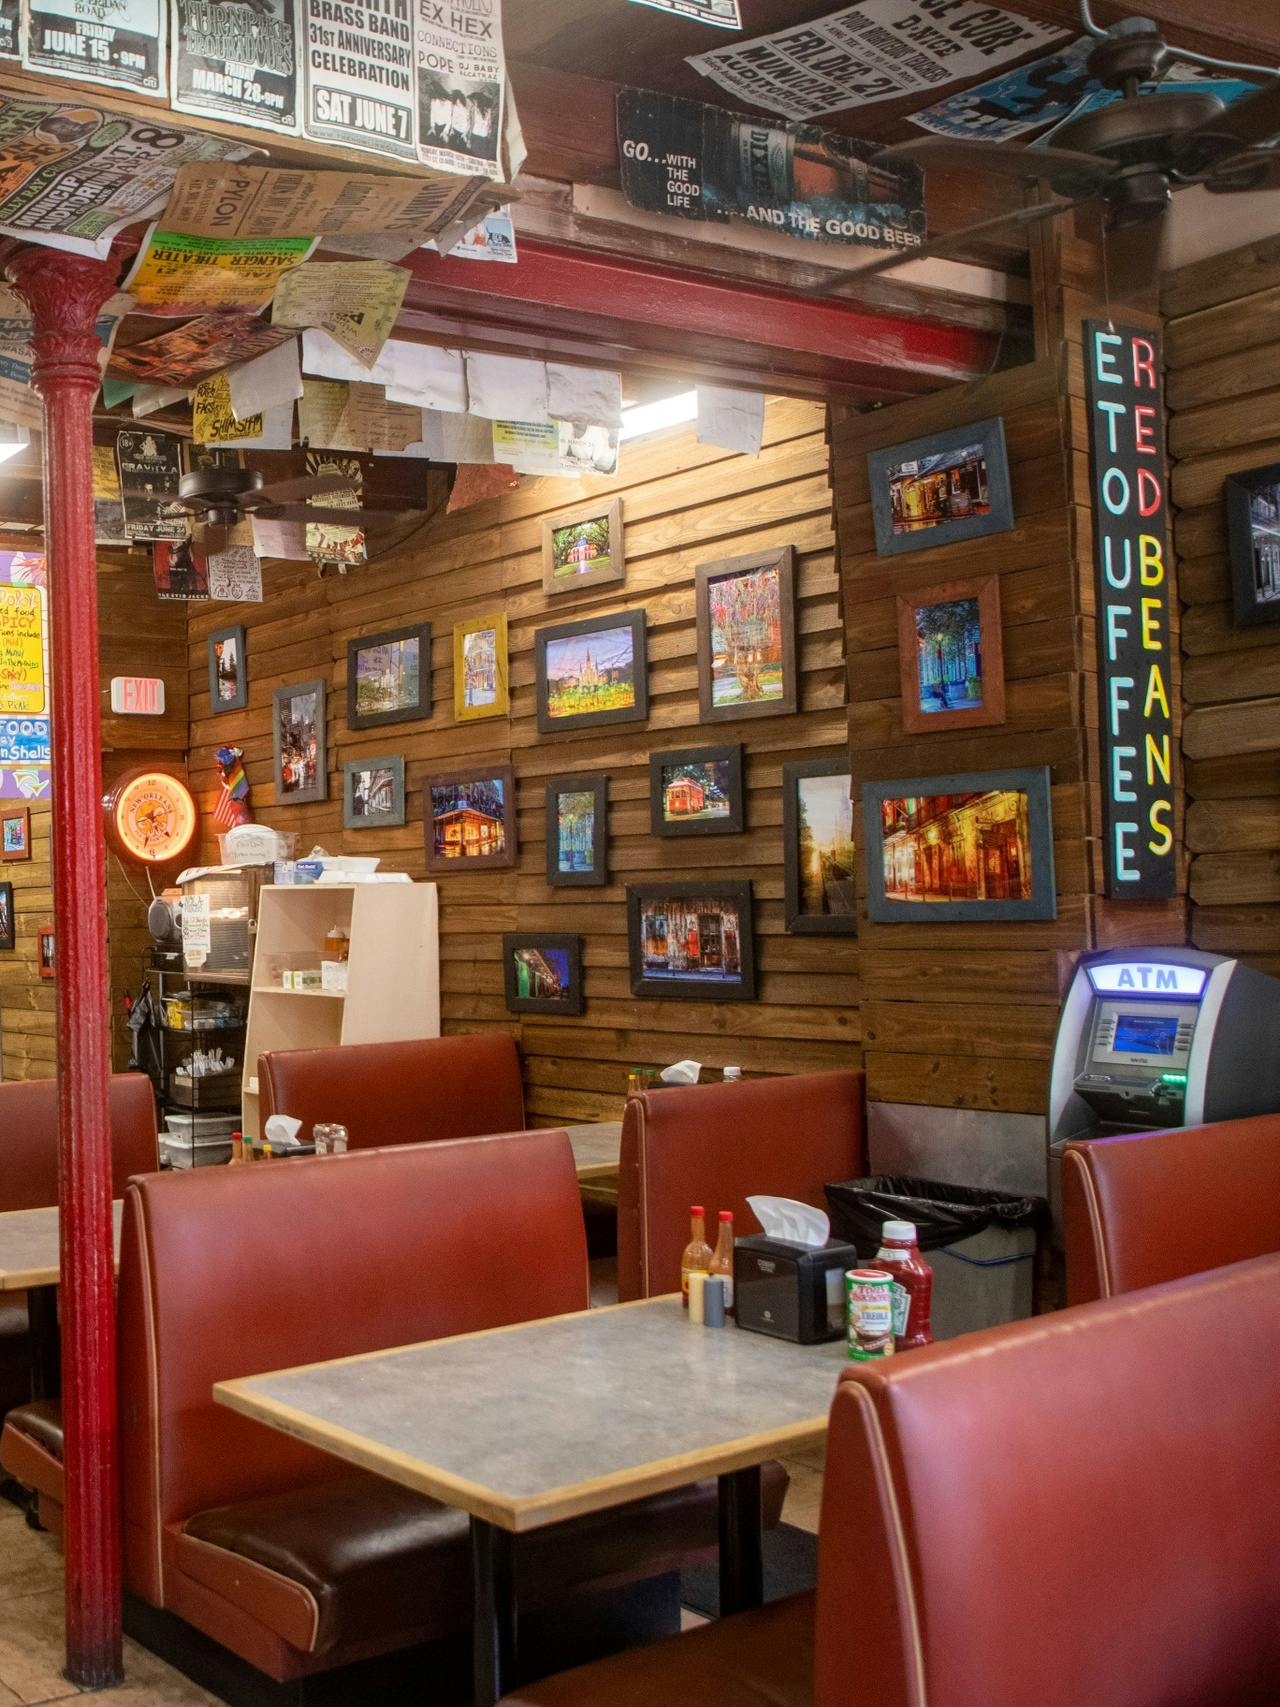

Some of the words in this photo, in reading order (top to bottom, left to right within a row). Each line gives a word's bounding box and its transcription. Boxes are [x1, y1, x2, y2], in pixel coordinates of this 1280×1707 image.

[75, 20, 117, 42] FRIDAY
[310, 2, 365, 29] BRASS
[368, 14, 410, 43] BAND
[420, 1, 444, 24] EX
[450, 12, 493, 39] HEX
[948, 8, 1036, 57] CUBE
[43, 30, 88, 56] JUNE
[89, 39, 110, 61] 15
[120, 54, 146, 70] 9PM
[310, 23, 335, 47] 31ST
[337, 30, 411, 68] ANNIVERSARY
[417, 30, 497, 58] CONNECTIONS
[225, 61, 256, 81] FRIDAY
[311, 50, 410, 91] CELEBRATION
[419, 51, 454, 74] POPE
[473, 63, 499, 73] BABY
[736, 45, 852, 106] MUNICIPAL
[192, 69, 243, 98] MARCH
[714, 54, 827, 114] AUDITORIUM
[851, 75, 904, 98] 21
[317, 89, 352, 124] SAT
[355, 97, 396, 137] JUNE
[398, 109, 409, 139] 7
[132, 126, 186, 150] 8
[666, 153, 696, 169] WITH
[666, 167, 689, 181] THE
[209, 179, 250, 226] PYLON
[666, 181, 700, 197] GOOD
[666, 194, 691, 209] LIFE
[788, 213, 821, 233] THE
[825, 219, 881, 241] GOOD
[882, 227, 921, 248] BEER
[152, 249, 219, 266] THEATER
[230, 254, 298, 266] SAENGER
[1131, 337, 1162, 517] RED
[122, 461, 167, 473] GRAVITY
[127, 524, 154, 532] FRIDAY
[156, 524, 174, 533] JUNE
[14, 607, 36, 616] food
[123, 678, 158, 713] EXIT
[1138, 534, 1174, 857] BEANS
[1117, 967, 1179, 990] ATM
